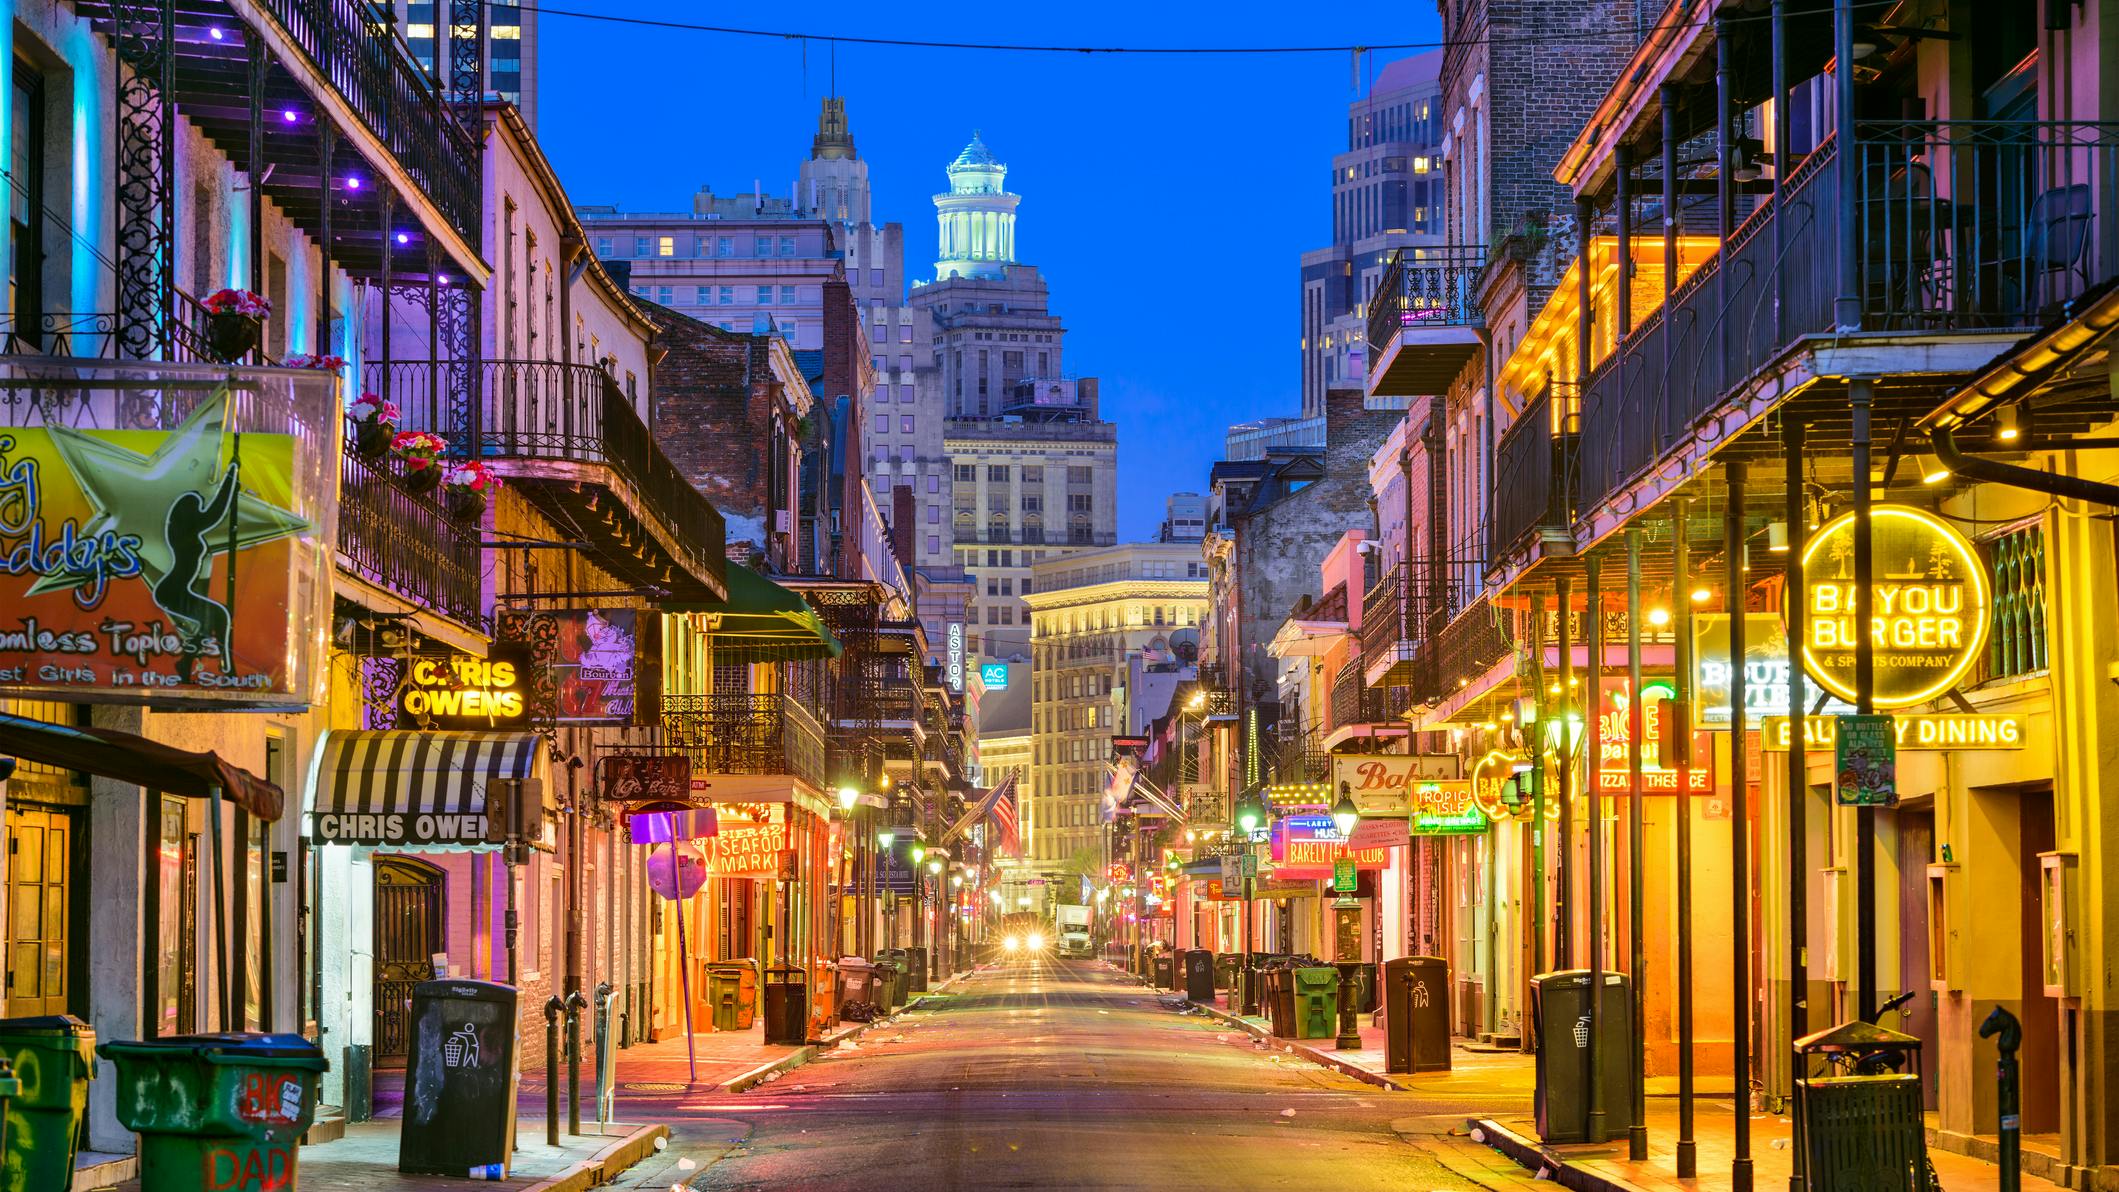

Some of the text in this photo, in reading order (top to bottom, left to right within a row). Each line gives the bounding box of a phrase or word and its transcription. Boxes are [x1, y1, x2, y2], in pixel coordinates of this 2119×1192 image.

[1812, 616, 1963, 648] BURGER
[101, 619, 221, 667] Topless
[949, 624, 961, 691] ASTOR
[1824, 655, 1954, 668] & SPTS COMPANY
[38, 665, 97, 682] Girls
[112, 669, 134, 687] in
[142, 670, 182, 687] the
[199, 671, 272, 688] South
[985, 667, 1004, 679] AC
[404, 690, 523, 718] OWENS
[1778, 719, 2017, 746] BALY DINING
[1600, 774, 1627, 787] IZZA
[1416, 791, 1472, 802] TROPICA
[1437, 803, 1464, 814] ISLE
[319, 814, 489, 840] CHRIS OWEN
[718, 828, 758, 839] PIER
[1315, 828, 1339, 838] HUS
[720, 836, 782, 855] SEAFOO
[1290, 842, 1327, 863] BARELY
[1361, 847, 1384, 863] CLUB
